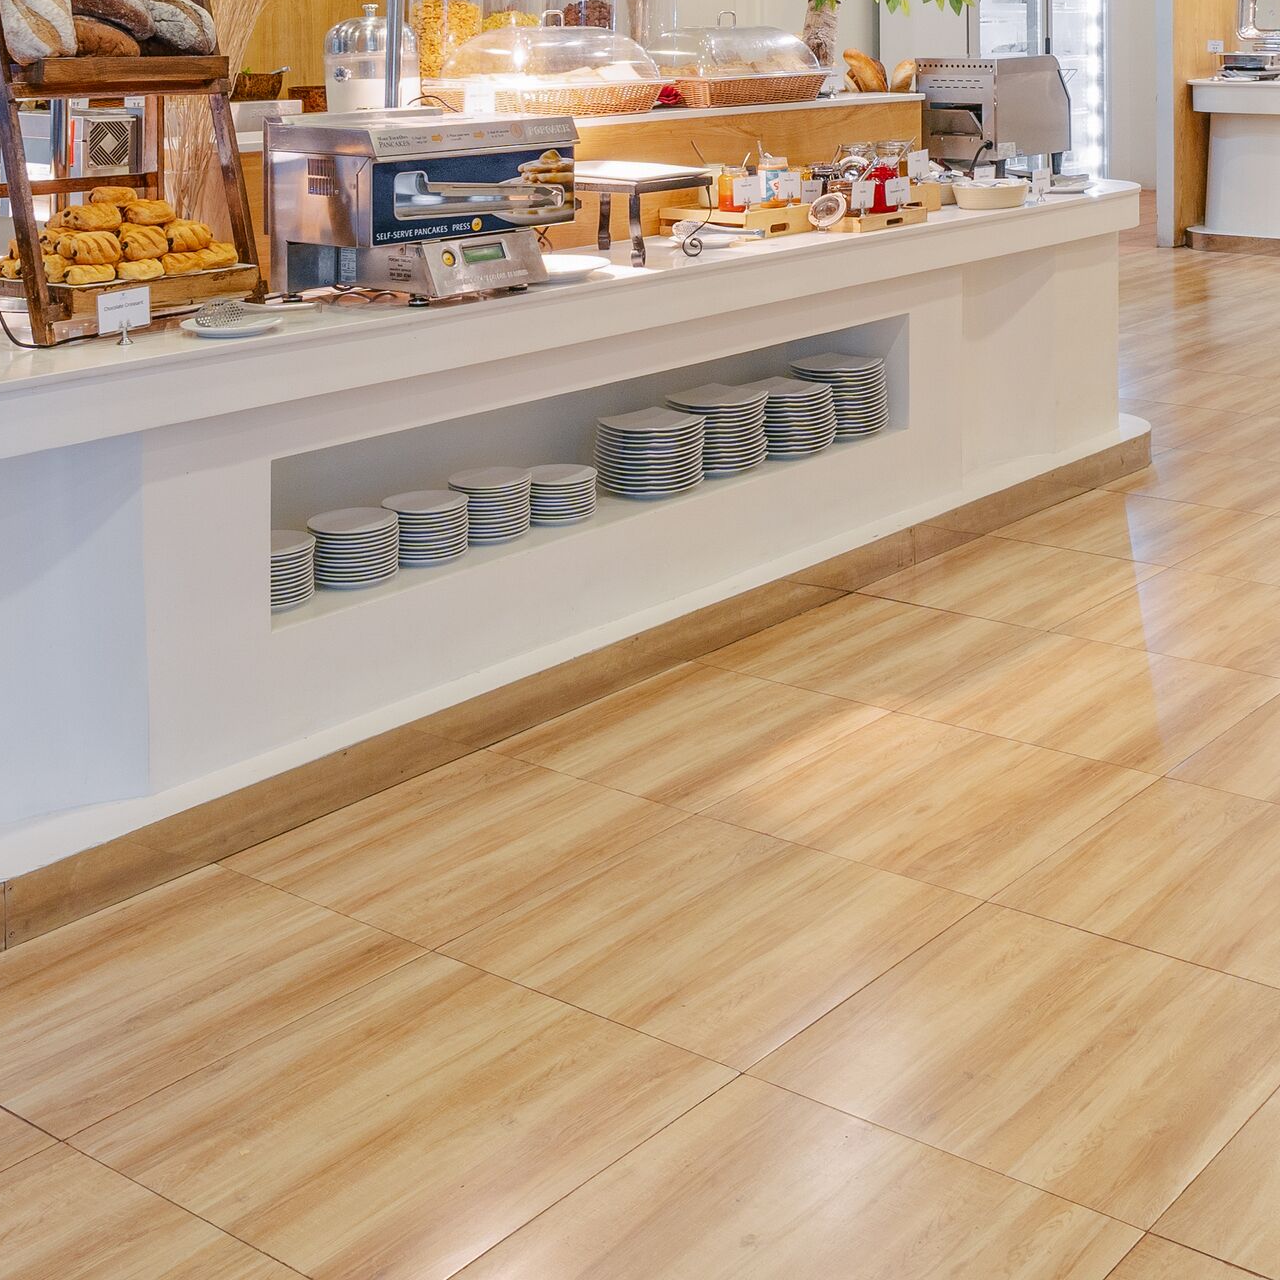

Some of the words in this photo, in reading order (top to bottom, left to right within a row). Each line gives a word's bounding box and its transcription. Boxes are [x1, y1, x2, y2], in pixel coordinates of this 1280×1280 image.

[375, 229, 414, 241] SELF-SERVE
[414, 224, 449, 237] PANCAKES
[451, 222, 471, 232] PRESS
[124, 300, 145, 308] Croissant
